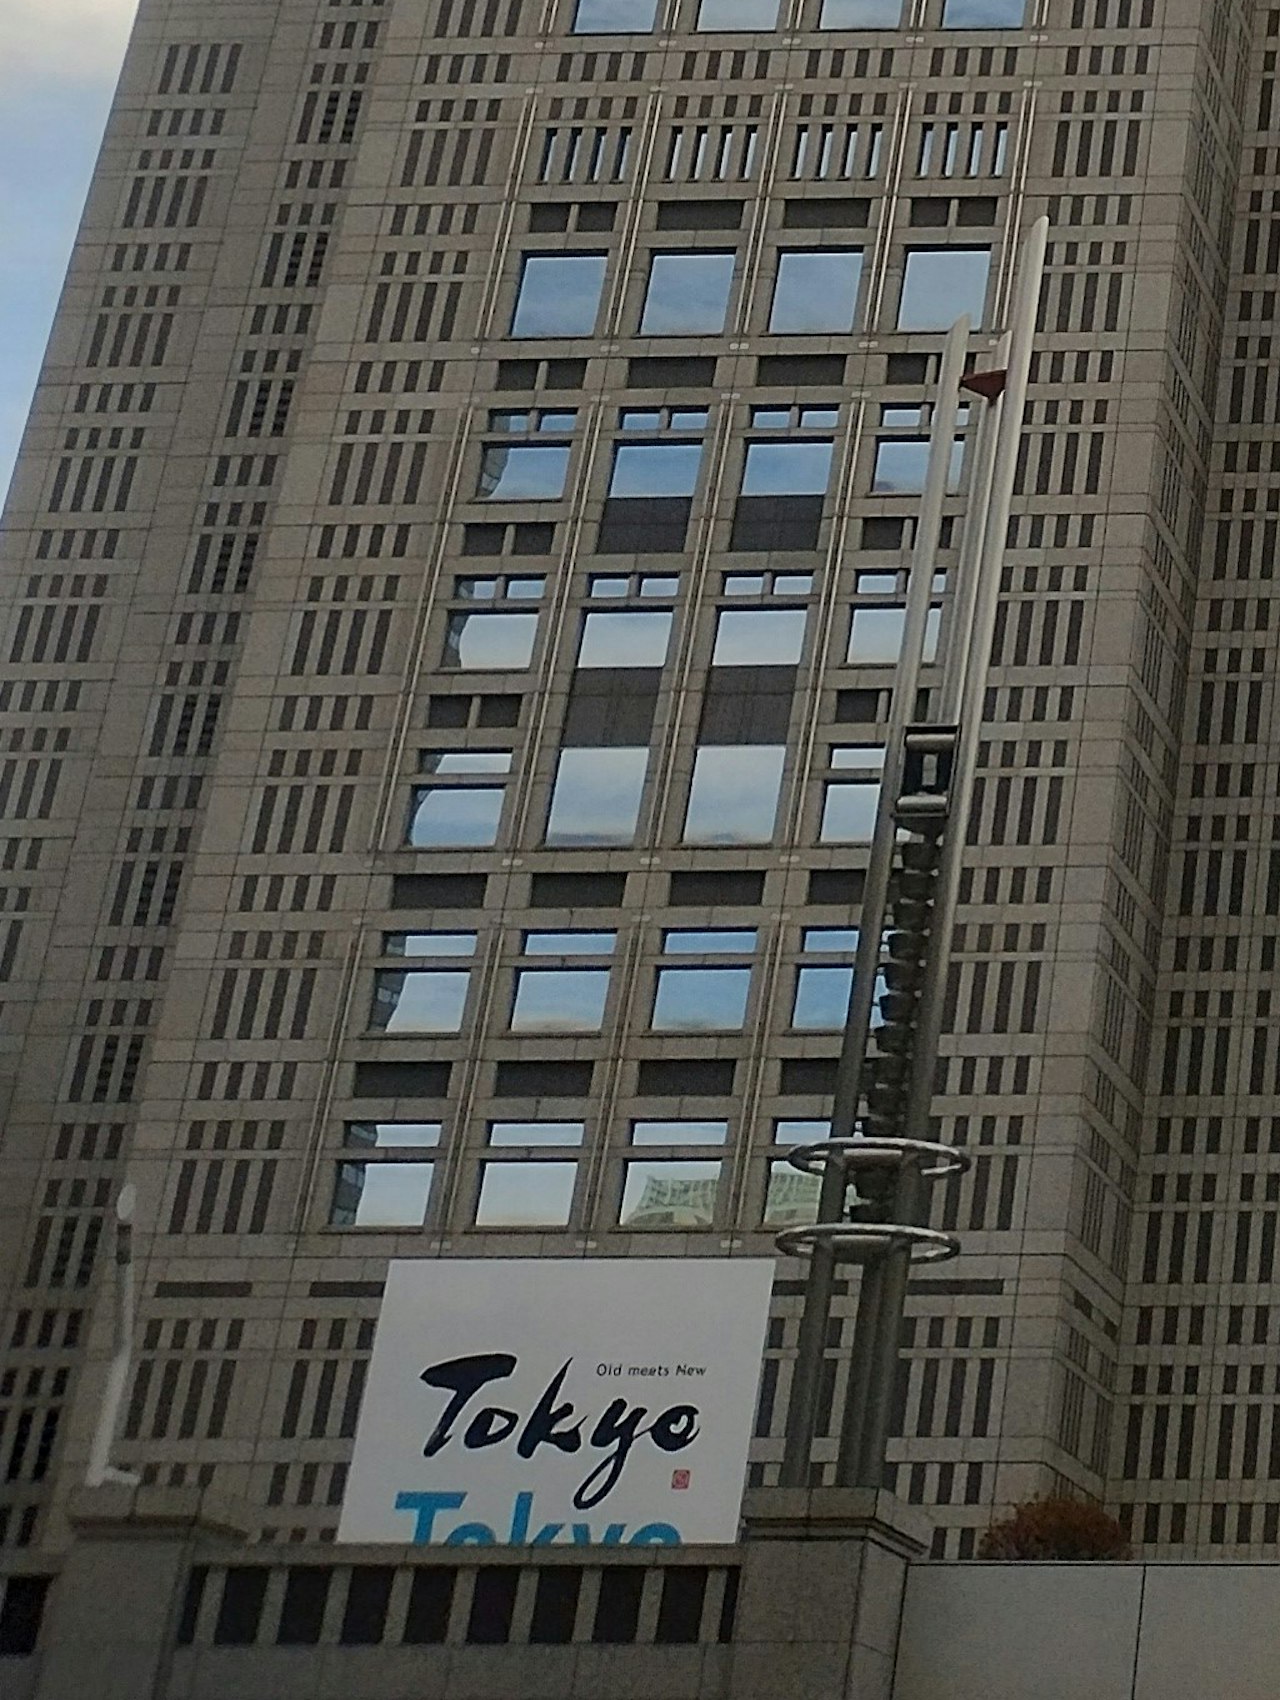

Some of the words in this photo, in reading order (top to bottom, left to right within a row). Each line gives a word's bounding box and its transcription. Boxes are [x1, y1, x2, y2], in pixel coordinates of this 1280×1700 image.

[595, 1362, 623, 1377] Old
[627, 1363, 670, 1377] meets
[675, 1363, 708, 1377] New
[419, 1353, 701, 1510] Tokyo
